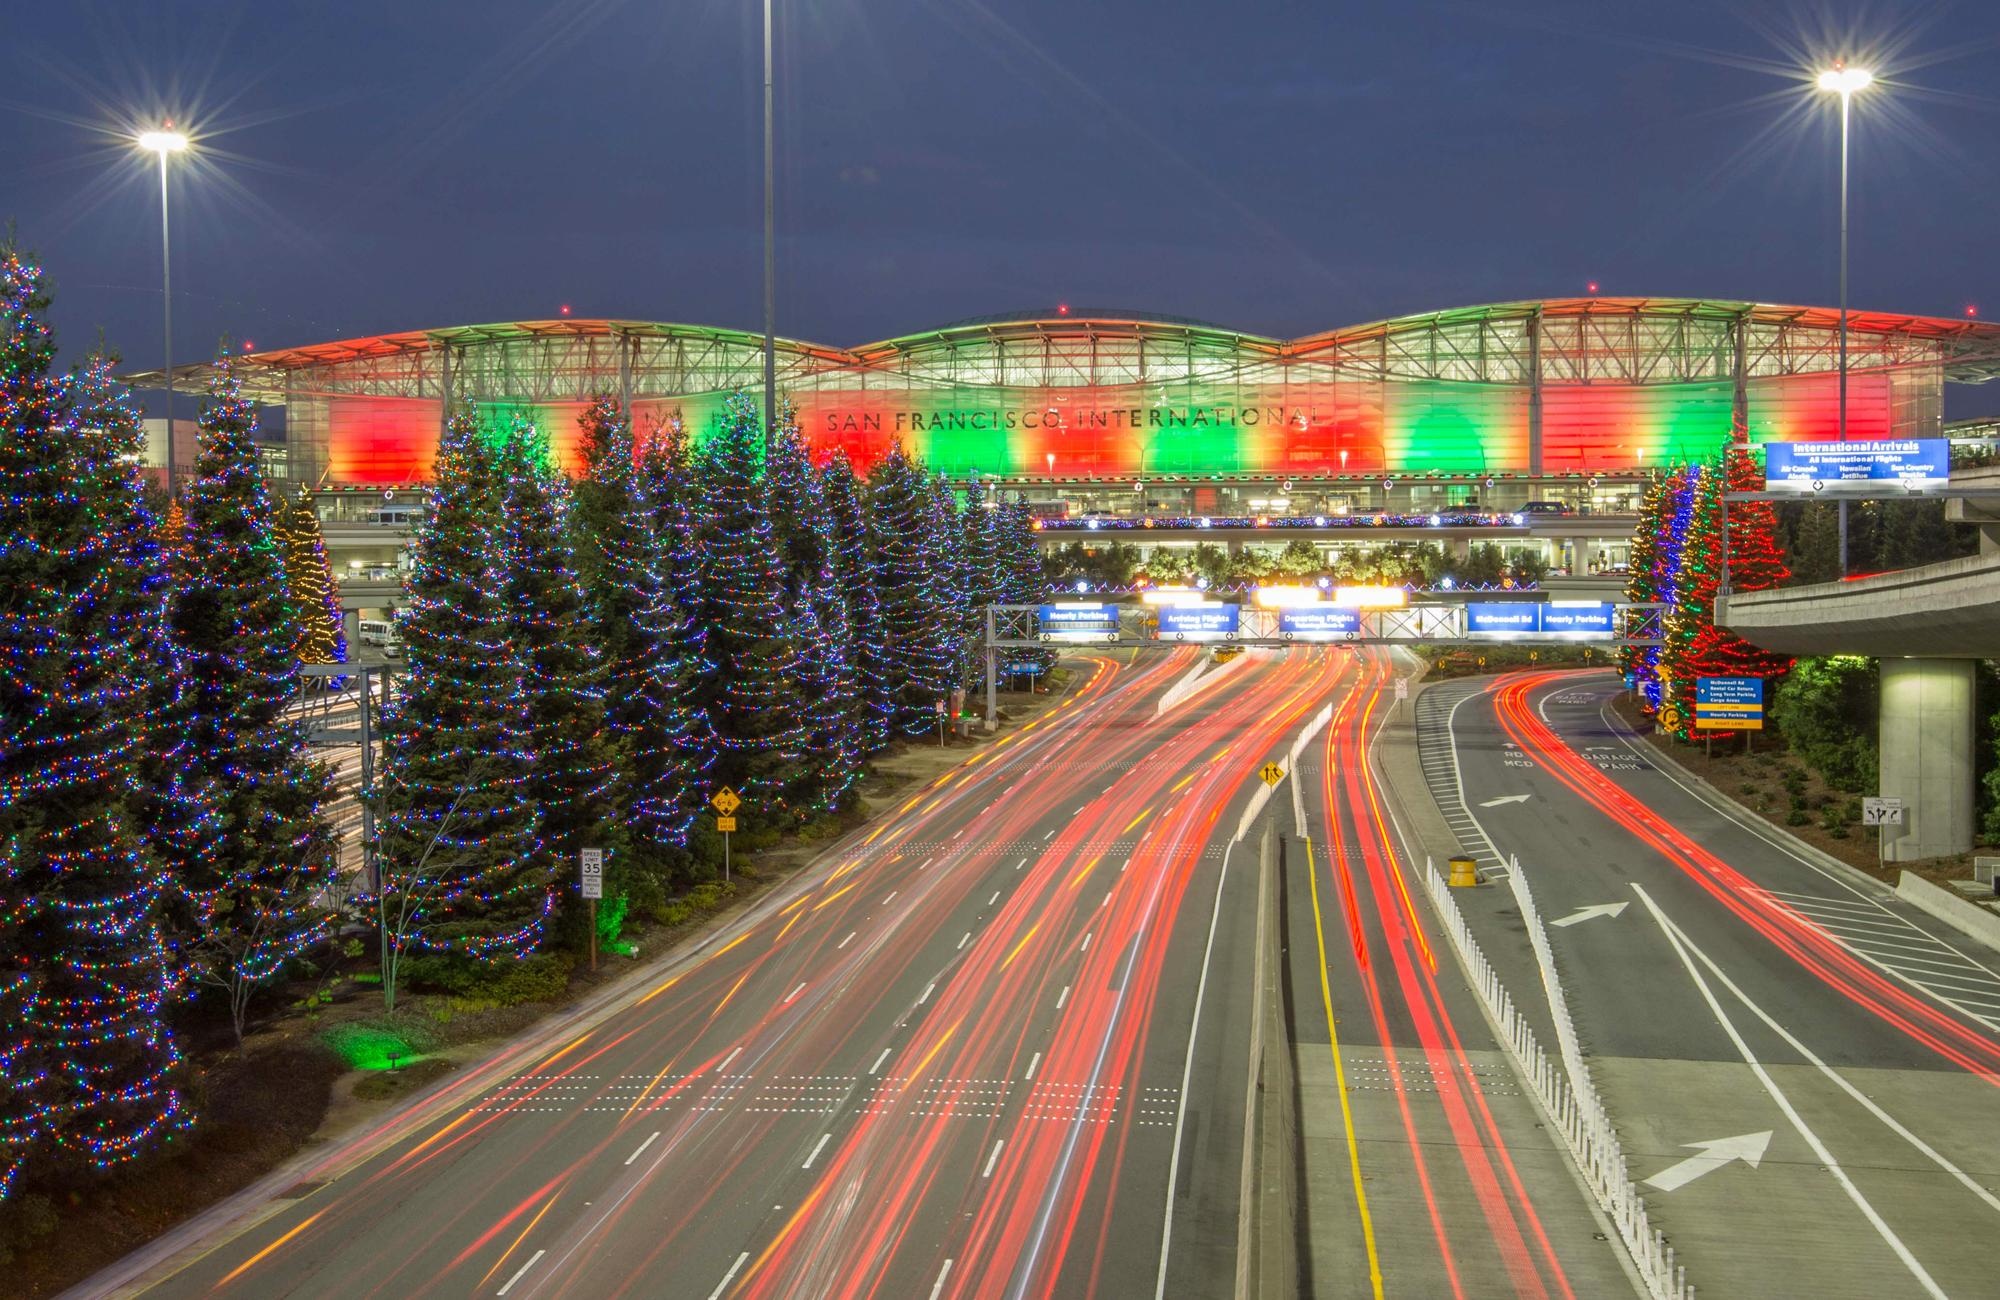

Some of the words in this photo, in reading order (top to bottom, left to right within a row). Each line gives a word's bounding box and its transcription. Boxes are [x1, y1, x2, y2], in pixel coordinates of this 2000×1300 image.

[827, 413, 881, 432] SAN
[895, 411, 1061, 431] FRANCISCO
[1077, 407, 1322, 428] INTERNATIONAL
[1793, 442, 1870, 453] International
[1872, 441, 1919, 451] Arrivals
[1875, 455, 1902, 463] Flights
[1905, 464, 1934, 472] Country
[1078, 612, 1108, 620] Parking
[1201, 615, 1229, 623] Flights
[1327, 615, 1354, 623] Flights
[1546, 615, 1573, 624] Hourly
[1575, 615, 1607, 624] Parking
[1581, 753, 1640, 761] GARAGE
[1504, 760, 1533, 768] MCD
[1599, 762, 1641, 770] PARK
[584, 863, 600, 873] 35
